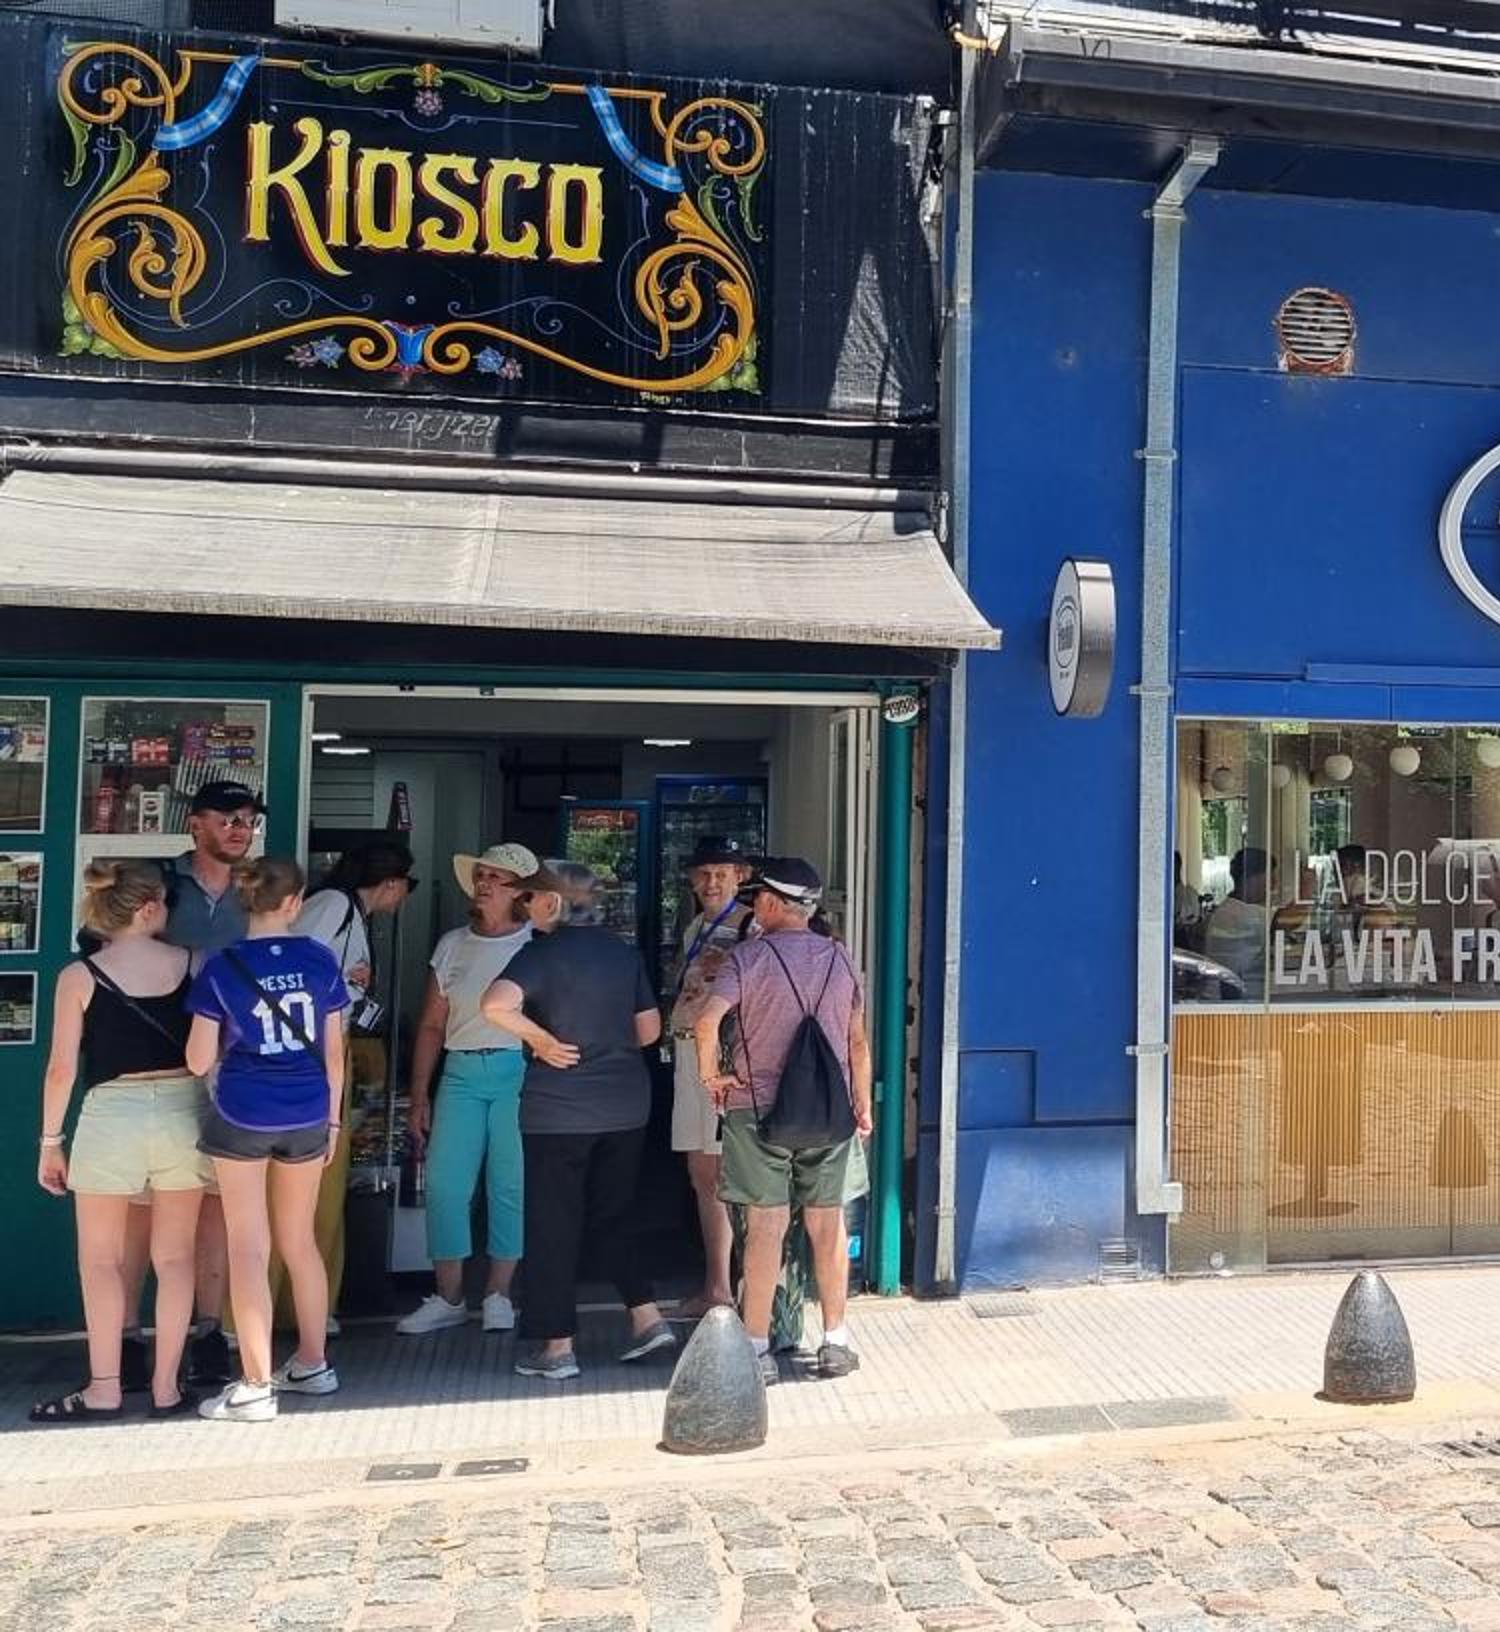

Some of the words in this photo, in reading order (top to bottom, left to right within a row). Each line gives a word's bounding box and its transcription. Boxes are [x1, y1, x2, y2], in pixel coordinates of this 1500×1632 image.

[1295, 849, 1349, 905] LA
[1365, 849, 1495, 905] DOLCE
[1275, 930, 1329, 985] LA
[1341, 929, 1437, 984] VITA
